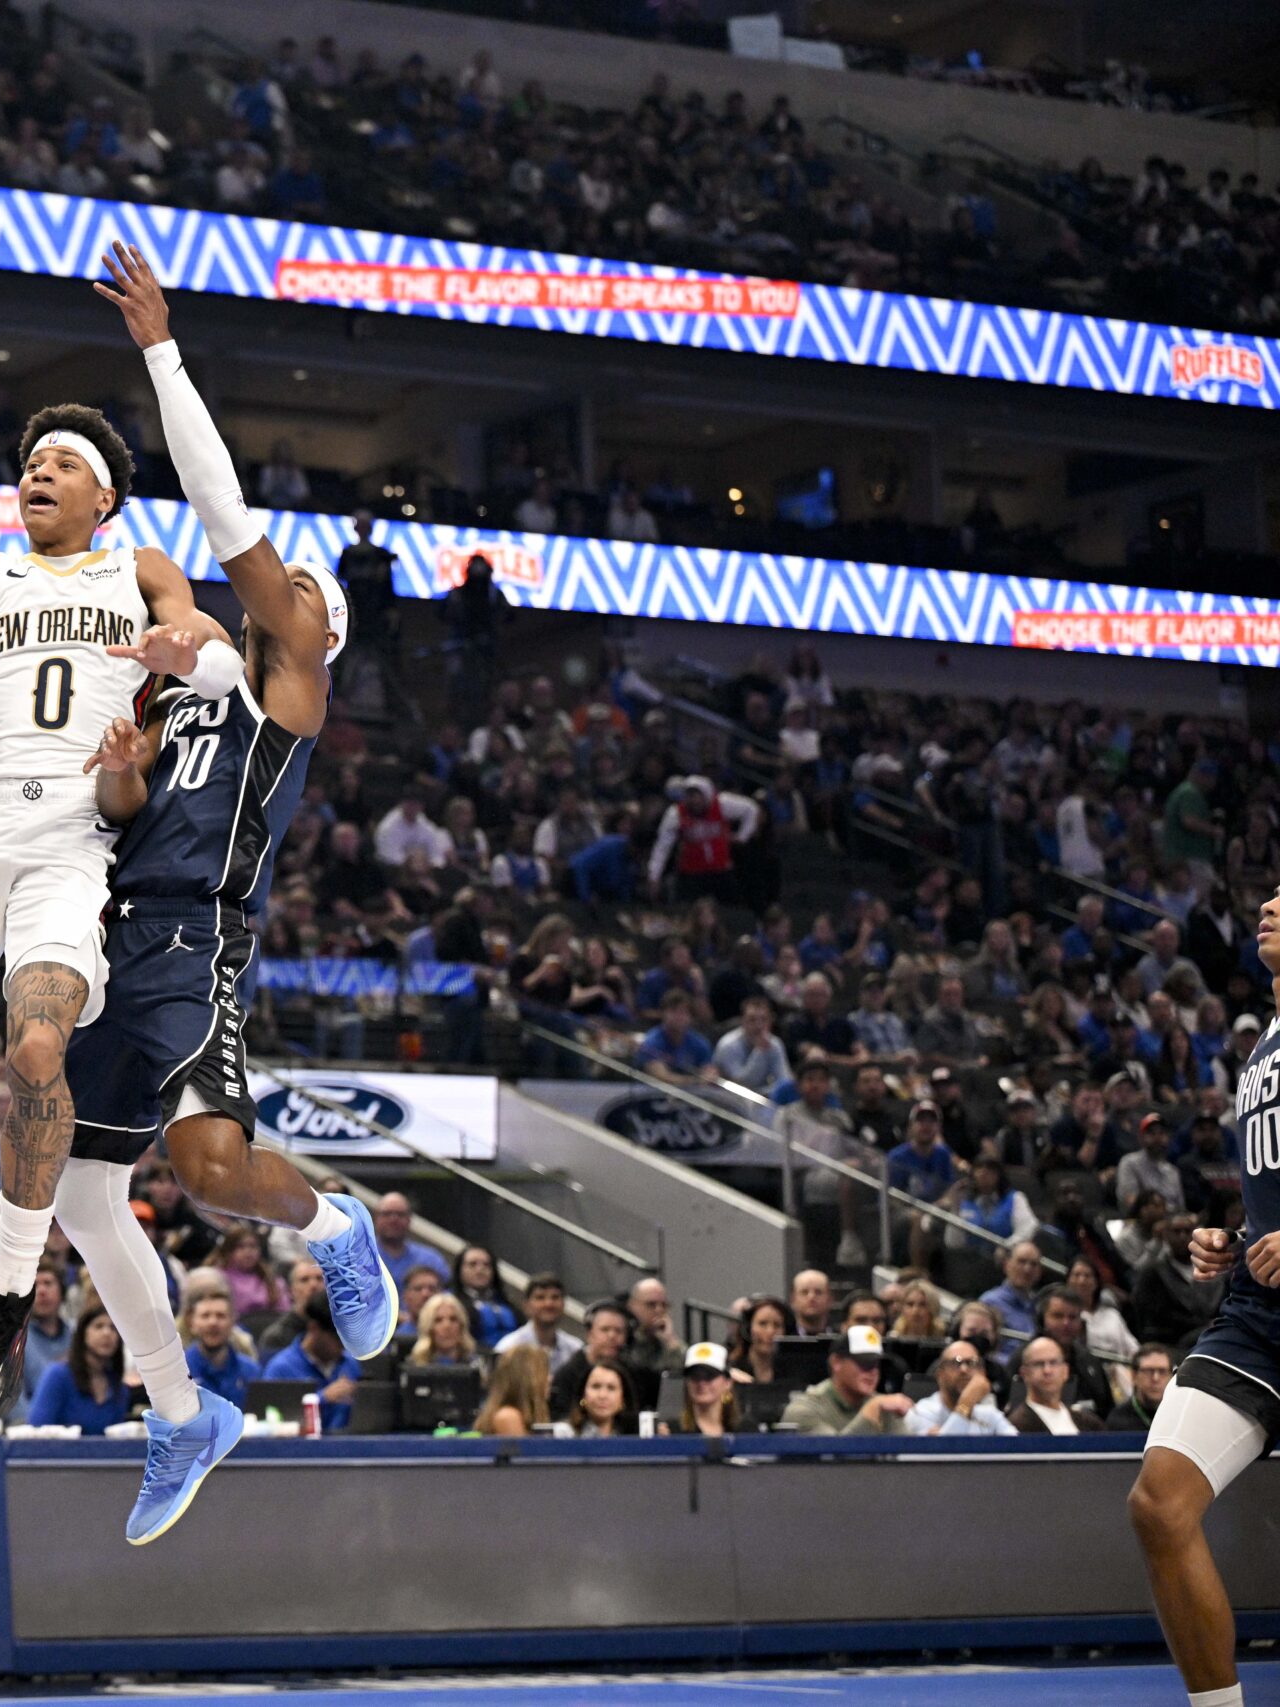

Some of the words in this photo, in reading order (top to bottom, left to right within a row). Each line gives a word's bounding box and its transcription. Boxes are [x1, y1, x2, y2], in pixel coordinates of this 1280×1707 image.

[280, 268, 384, 298] CHOOSE
[391, 272, 439, 300] THE
[444, 275, 541, 305] FLAVOR
[546, 278, 607, 307] THAT
[611, 281, 705, 310] SPEAKS
[711, 284, 743, 311] TO
[747, 285, 796, 314] YOU
[1172, 345, 1262, 385] RUFFLES
[81, 566, 121, 577] NEWAGE
[37, 606, 135, 647] ORLEANS
[1016, 618, 1103, 645] CHOOSE
[1109, 618, 1152, 644] THE
[1154, 619, 1236, 644] FLAVOR
[32, 656, 75, 731] 0
[166, 733, 220, 792] 10
[277, 1086, 381, 1138] Ford
[1246, 1105, 1280, 1176] 00
